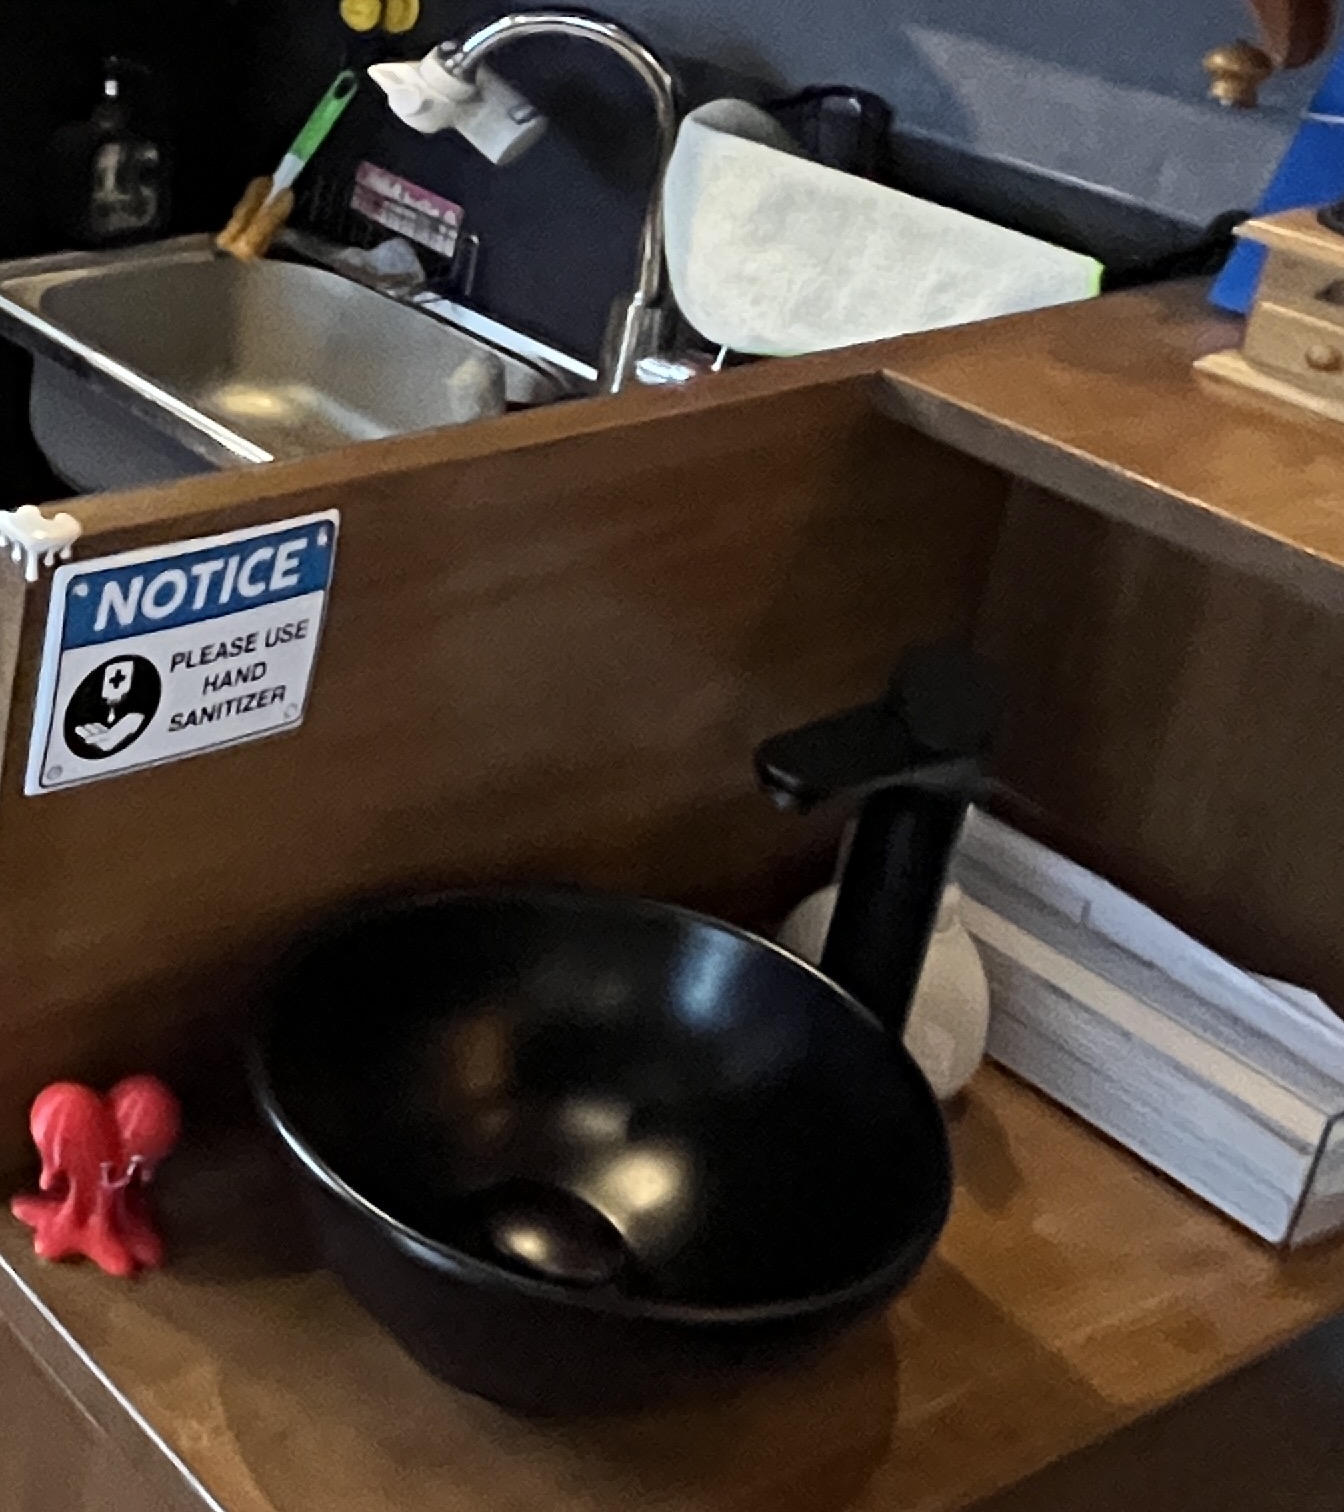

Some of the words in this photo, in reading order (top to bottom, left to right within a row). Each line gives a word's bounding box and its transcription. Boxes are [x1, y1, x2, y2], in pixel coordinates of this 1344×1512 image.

[94, 539, 308, 632] NOTICE
[169, 631, 259, 673] PLEASE
[264, 618, 310, 648] USE
[202, 661, 267, 696] HAND
[168, 684, 286, 732] SANITIZER
